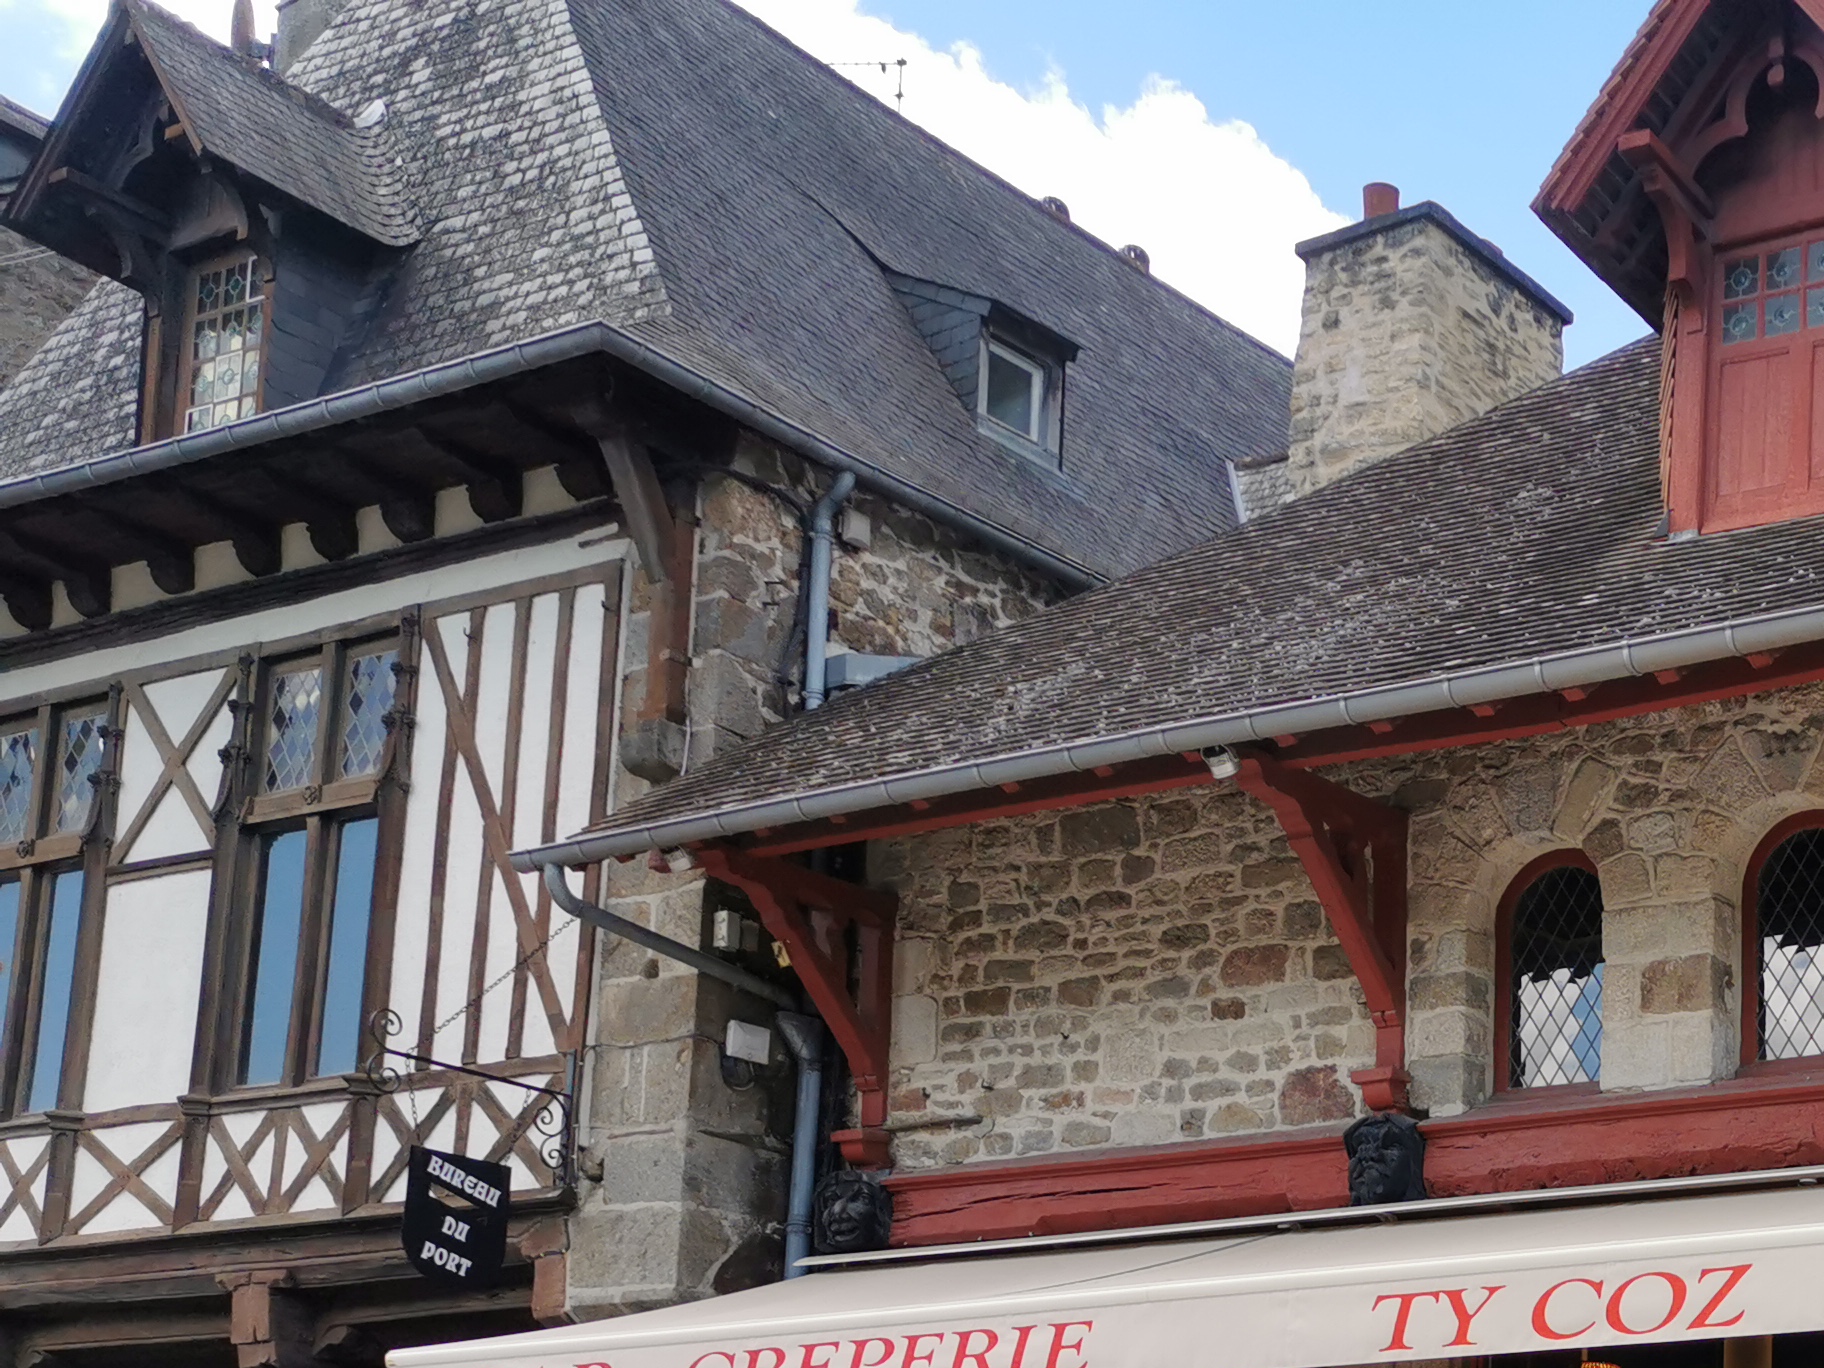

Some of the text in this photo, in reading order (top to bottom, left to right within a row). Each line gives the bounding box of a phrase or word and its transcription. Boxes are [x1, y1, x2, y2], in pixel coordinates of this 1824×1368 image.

[426, 1154, 502, 1208] BUREAU
[441, 1215, 471, 1242] DU
[420, 1240, 473, 1277] PORT
[1371, 1262, 1755, 1353] TY COZ
